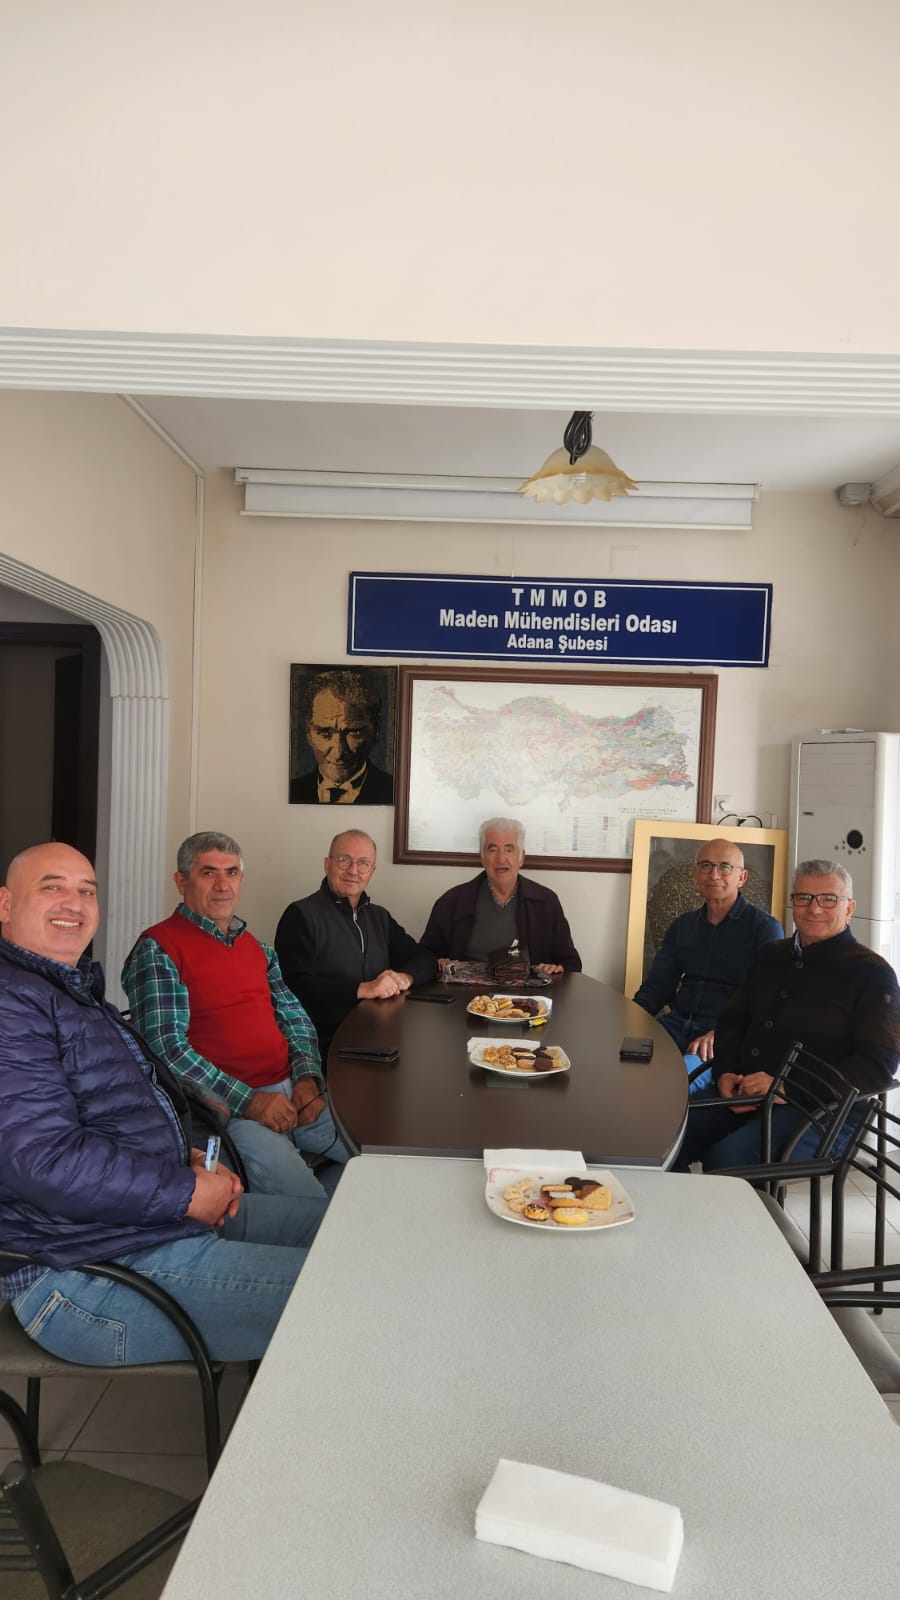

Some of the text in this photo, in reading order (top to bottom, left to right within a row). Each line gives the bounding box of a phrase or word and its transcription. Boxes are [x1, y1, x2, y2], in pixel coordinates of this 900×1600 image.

[439, 608, 677, 634] Maden Mühendisleri Odası
[506, 633, 608, 654] Adana Şubesi
